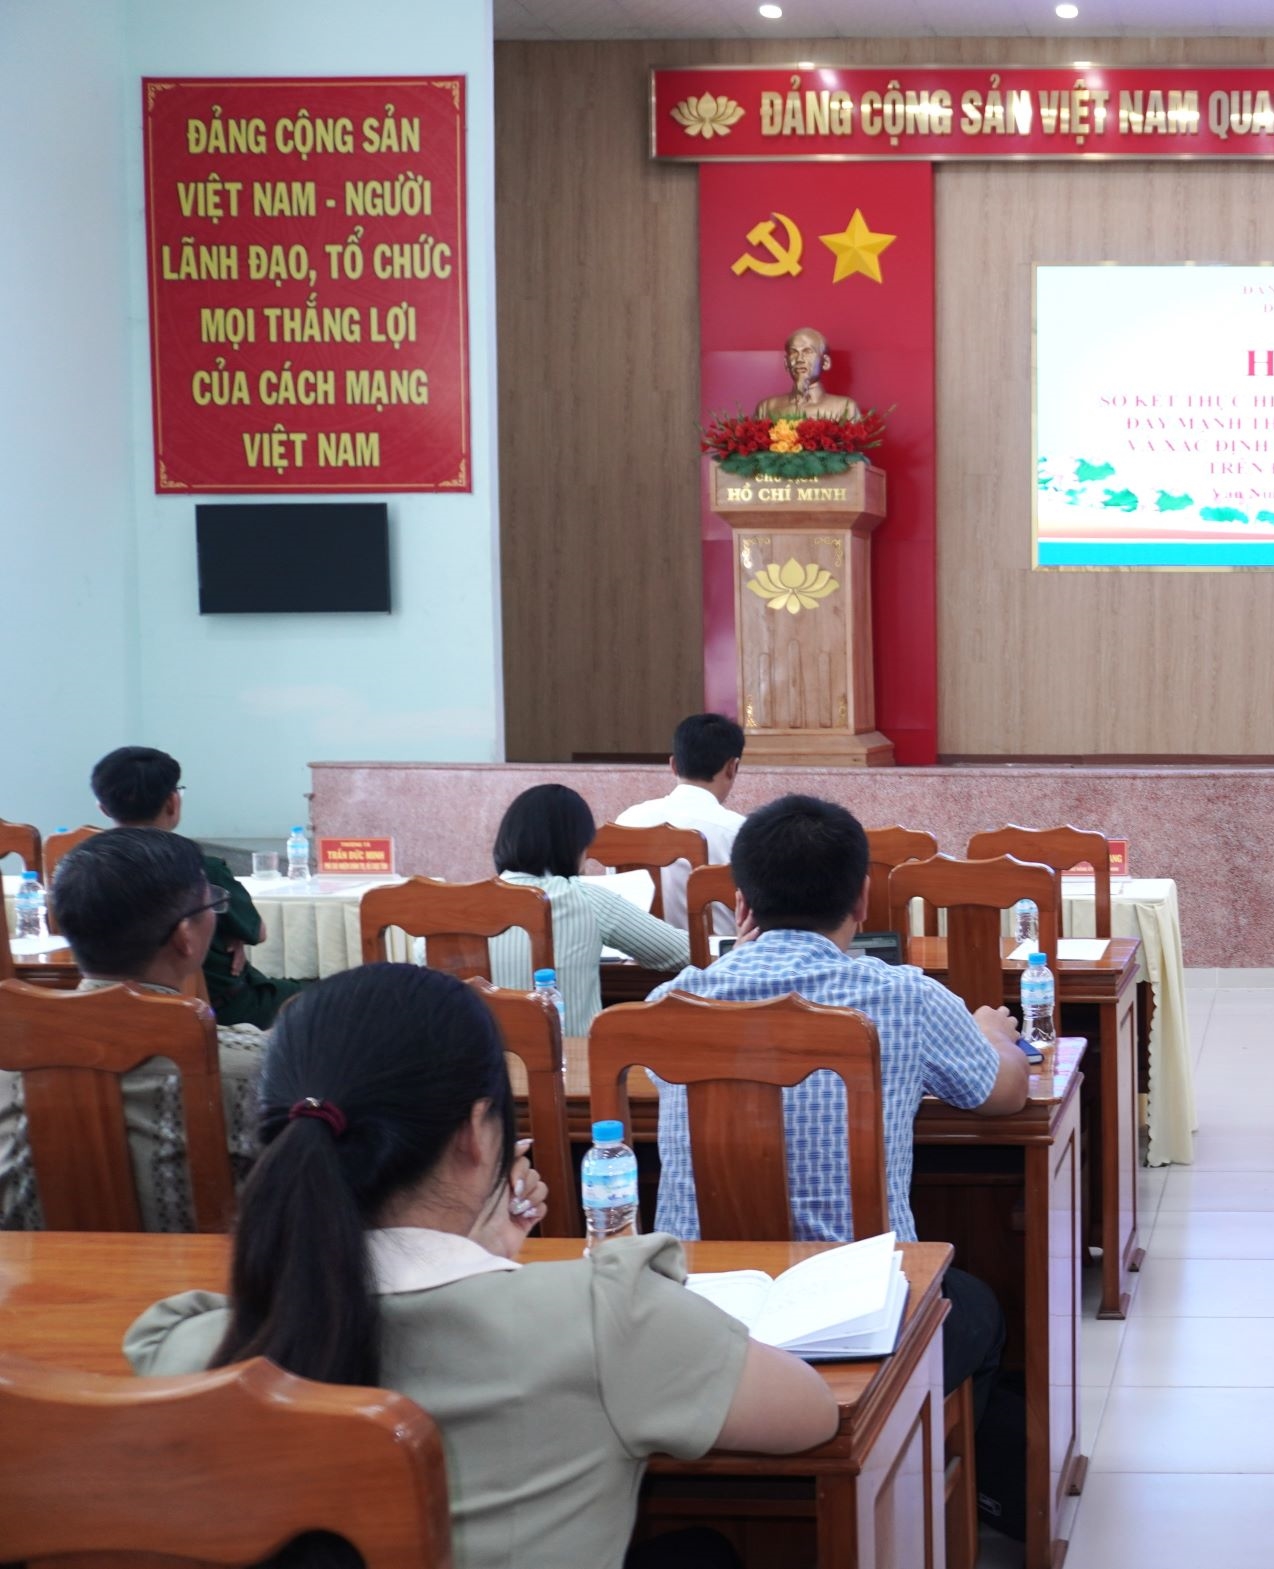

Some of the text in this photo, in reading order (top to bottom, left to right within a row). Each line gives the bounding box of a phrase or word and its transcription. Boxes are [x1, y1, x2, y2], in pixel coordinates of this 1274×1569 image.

[187, 103, 420, 160] ĐẢNG CỘNG SẢN
[760, 75, 853, 135] ĐẢNG
[861, 81, 952, 145] CỘNG
[961, 74, 1031, 135] SẢN
[1039, 80, 1110, 144] VIỆT
[1119, 90, 1199, 135] NAM
[177, 173, 243, 224] VIỆT
[253, 182, 316, 216] NAM
[345, 171, 431, 216] NGƯỜI
[162, 225, 451, 287] LÃNH ĐẠO, TỔ CHỨC
[201, 292, 416, 350] MỌI THẮNG LỢI
[192, 358, 428, 412] CỦA CÁCH MẠNG
[243, 424, 380, 474] VIỆT NAM
[727, 482, 847, 501] HỒ CHÍ MINH
